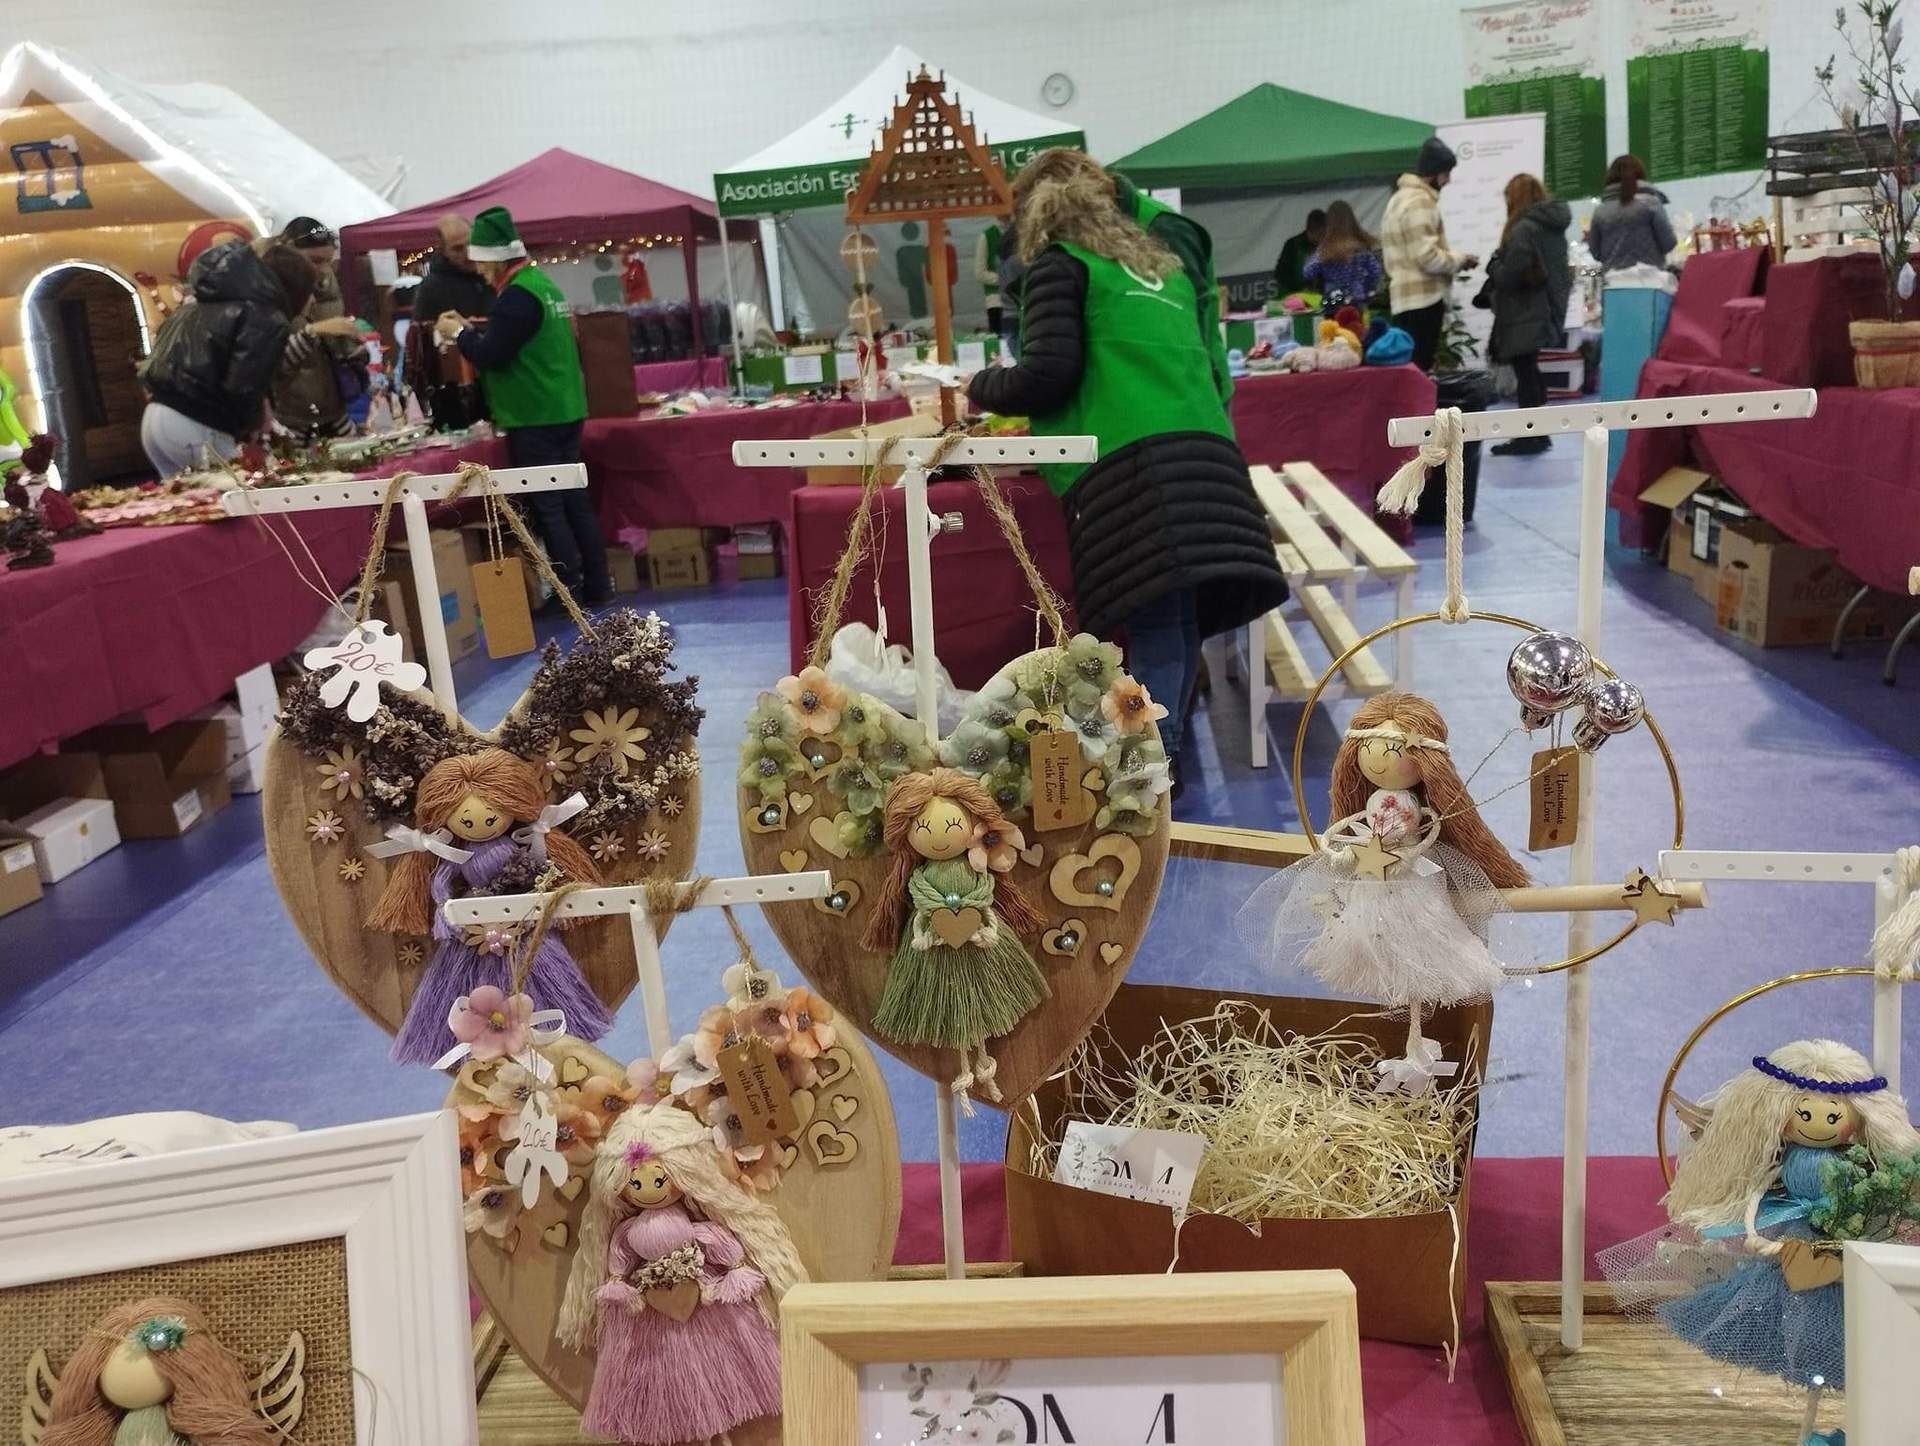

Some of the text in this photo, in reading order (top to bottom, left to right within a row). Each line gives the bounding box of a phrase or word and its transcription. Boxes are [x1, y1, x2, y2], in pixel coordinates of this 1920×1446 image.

[721, 173, 825, 202] Asociación
[1228, 279, 1279, 303] NUES
[331, 641, 395, 676] 20€
[1043, 756, 1057, 804] with Love
[1056, 756, 1070, 806] Handmade
[1543, 774, 1554, 823] with Love
[1555, 772, 1569, 825] Handmade
[736, 1068, 761, 1116] with Love
[752, 1063, 779, 1113] Handmade
[522, 1121, 553, 1153] 20€
